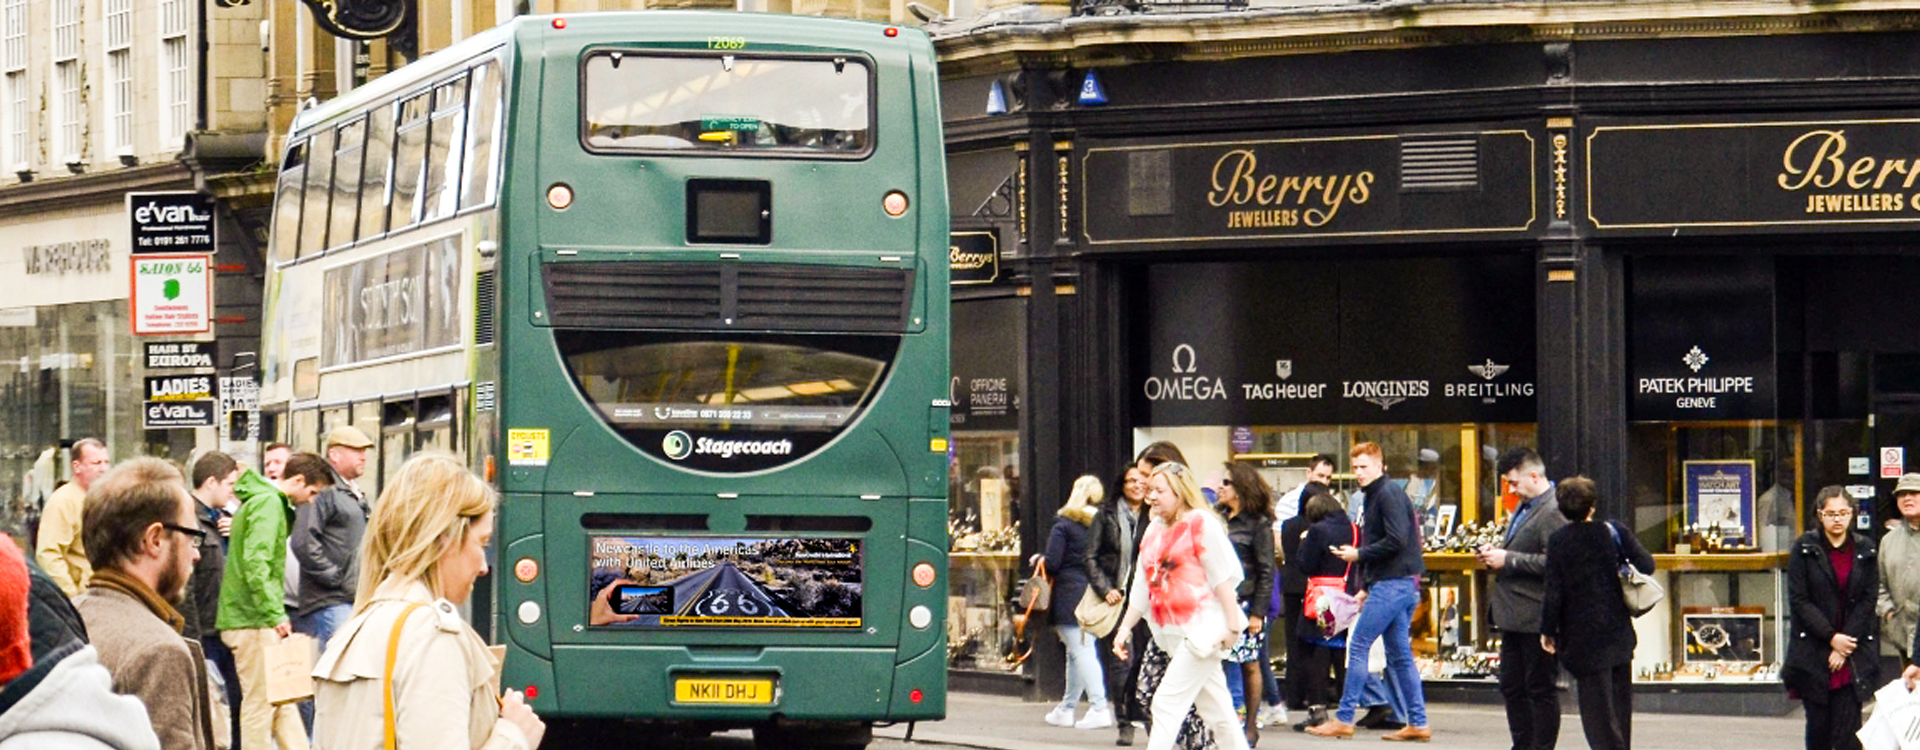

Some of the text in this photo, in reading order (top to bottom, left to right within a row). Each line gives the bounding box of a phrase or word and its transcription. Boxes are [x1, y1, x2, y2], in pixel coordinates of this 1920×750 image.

[707, 36, 745, 49] 12069
[1778, 129, 1920, 211] Berr
[1208, 150, 1375, 227] Berrys
[1806, 193, 1904, 213] JEWELLERS
[1227, 209, 1299, 228] JEWELLERS
[149, 344, 198, 354] HAIR BY
[149, 354, 212, 367] EUROPA
[151, 377, 211, 396] LADIES
[1144, 376, 1227, 400] OMEGA
[1242, 384, 1274, 399] TAG
[1342, 380, 1430, 398] LONGINES
[1444, 383, 1535, 397] BREITLING
[1639, 376, 1754, 393] PATEK PHILIPPE
[970, 393, 1007, 405] PANERAI
[695, 437, 792, 458] Stagecoach
[596, 541, 759, 556] Newcastle to the Americas
[596, 556, 715, 570] with United Airlines
[725, 683, 758, 699] DHJ
